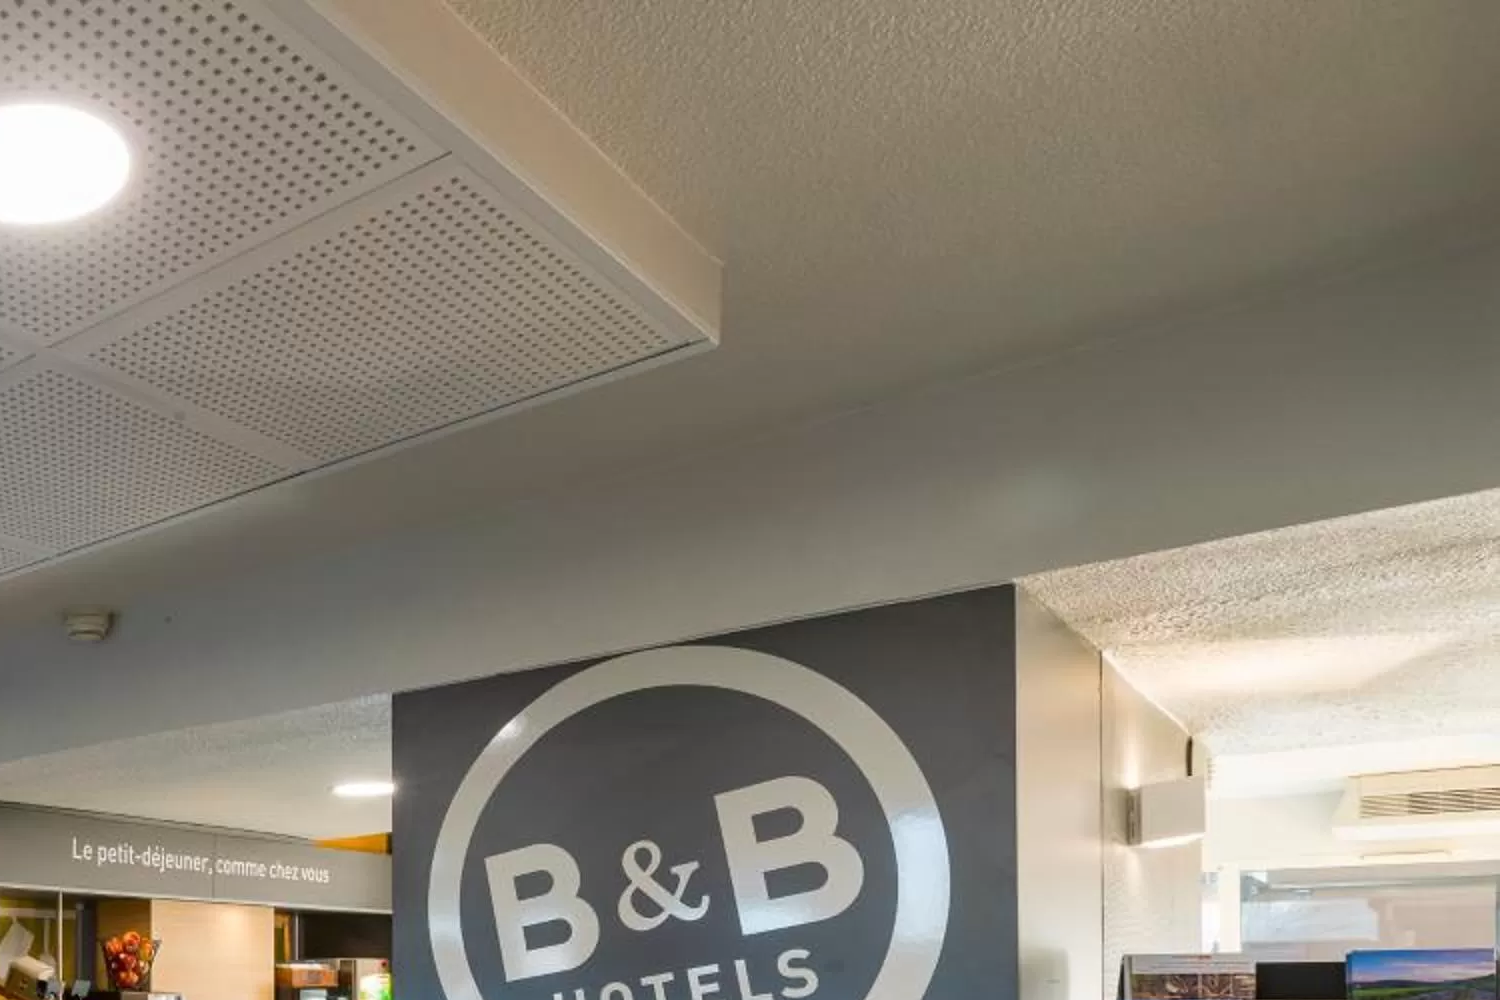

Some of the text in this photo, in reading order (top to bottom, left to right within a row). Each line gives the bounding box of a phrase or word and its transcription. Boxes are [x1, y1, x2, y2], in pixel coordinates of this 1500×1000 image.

[72, 837, 330, 884] Le petit-déjeuner, comme chez vous
